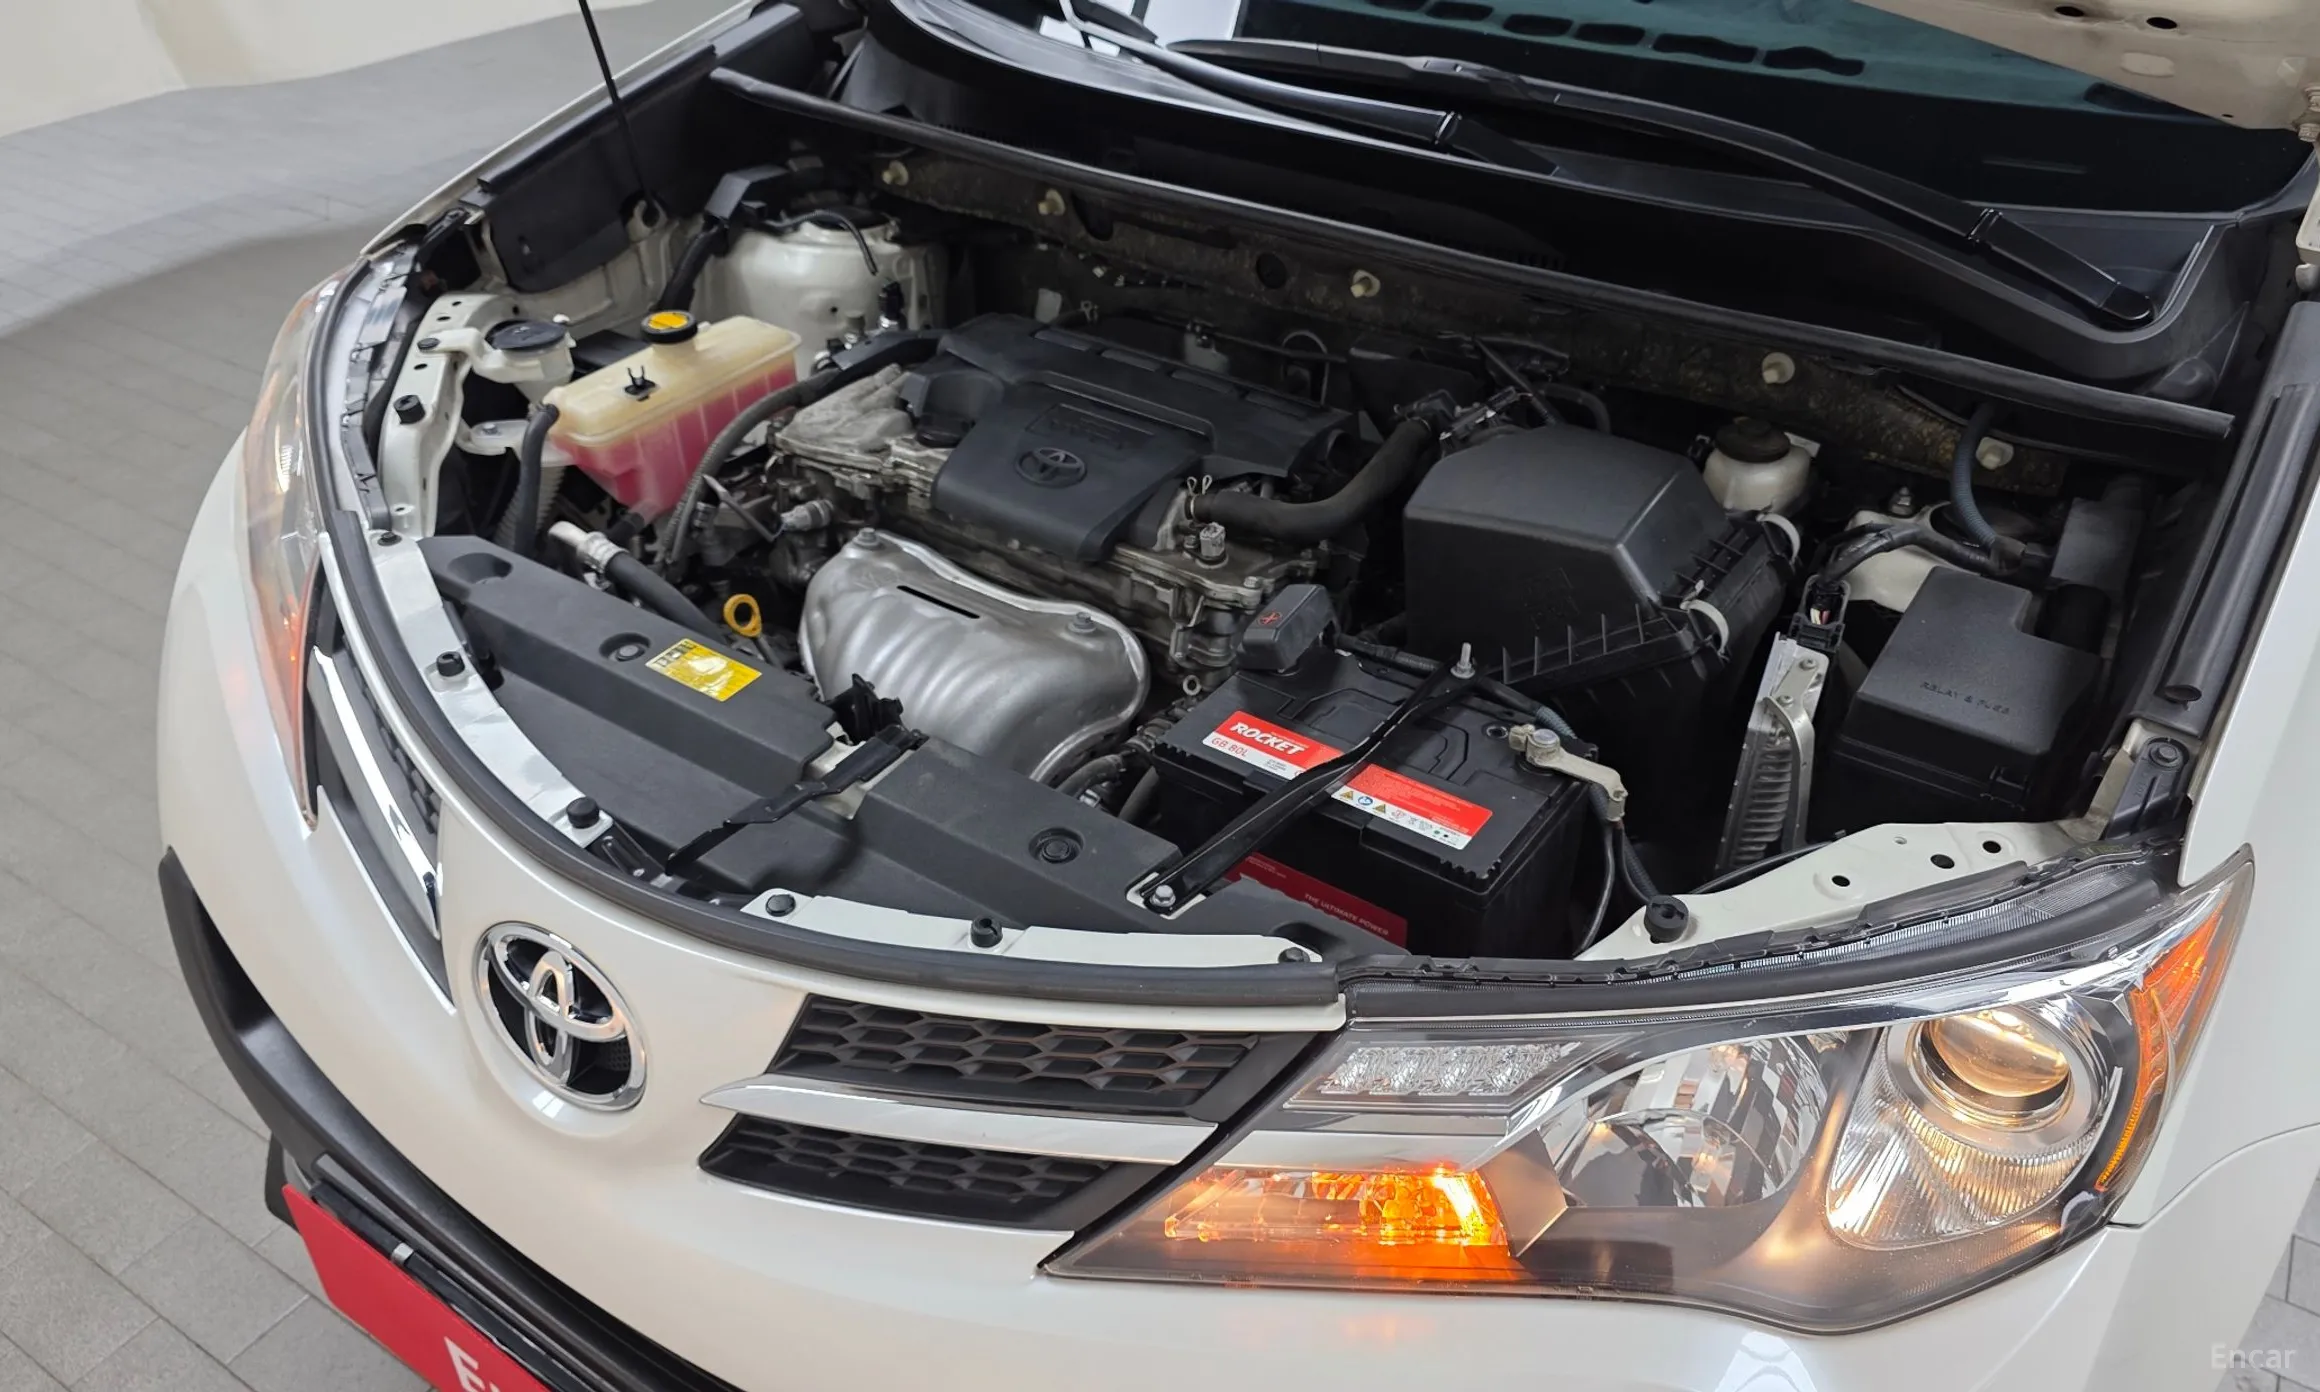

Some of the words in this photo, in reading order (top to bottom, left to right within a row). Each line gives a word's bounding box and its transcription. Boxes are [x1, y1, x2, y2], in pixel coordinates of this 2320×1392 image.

[1211, 737, 1228, 747] GB
[1228, 743, 1249, 757] 80L
[1230, 722, 1305, 755] ROCKET
[1305, 893, 1319, 904] THE
[1320, 901, 1358, 922] ULTIMATE
[1358, 917, 1390, 936] POWER
